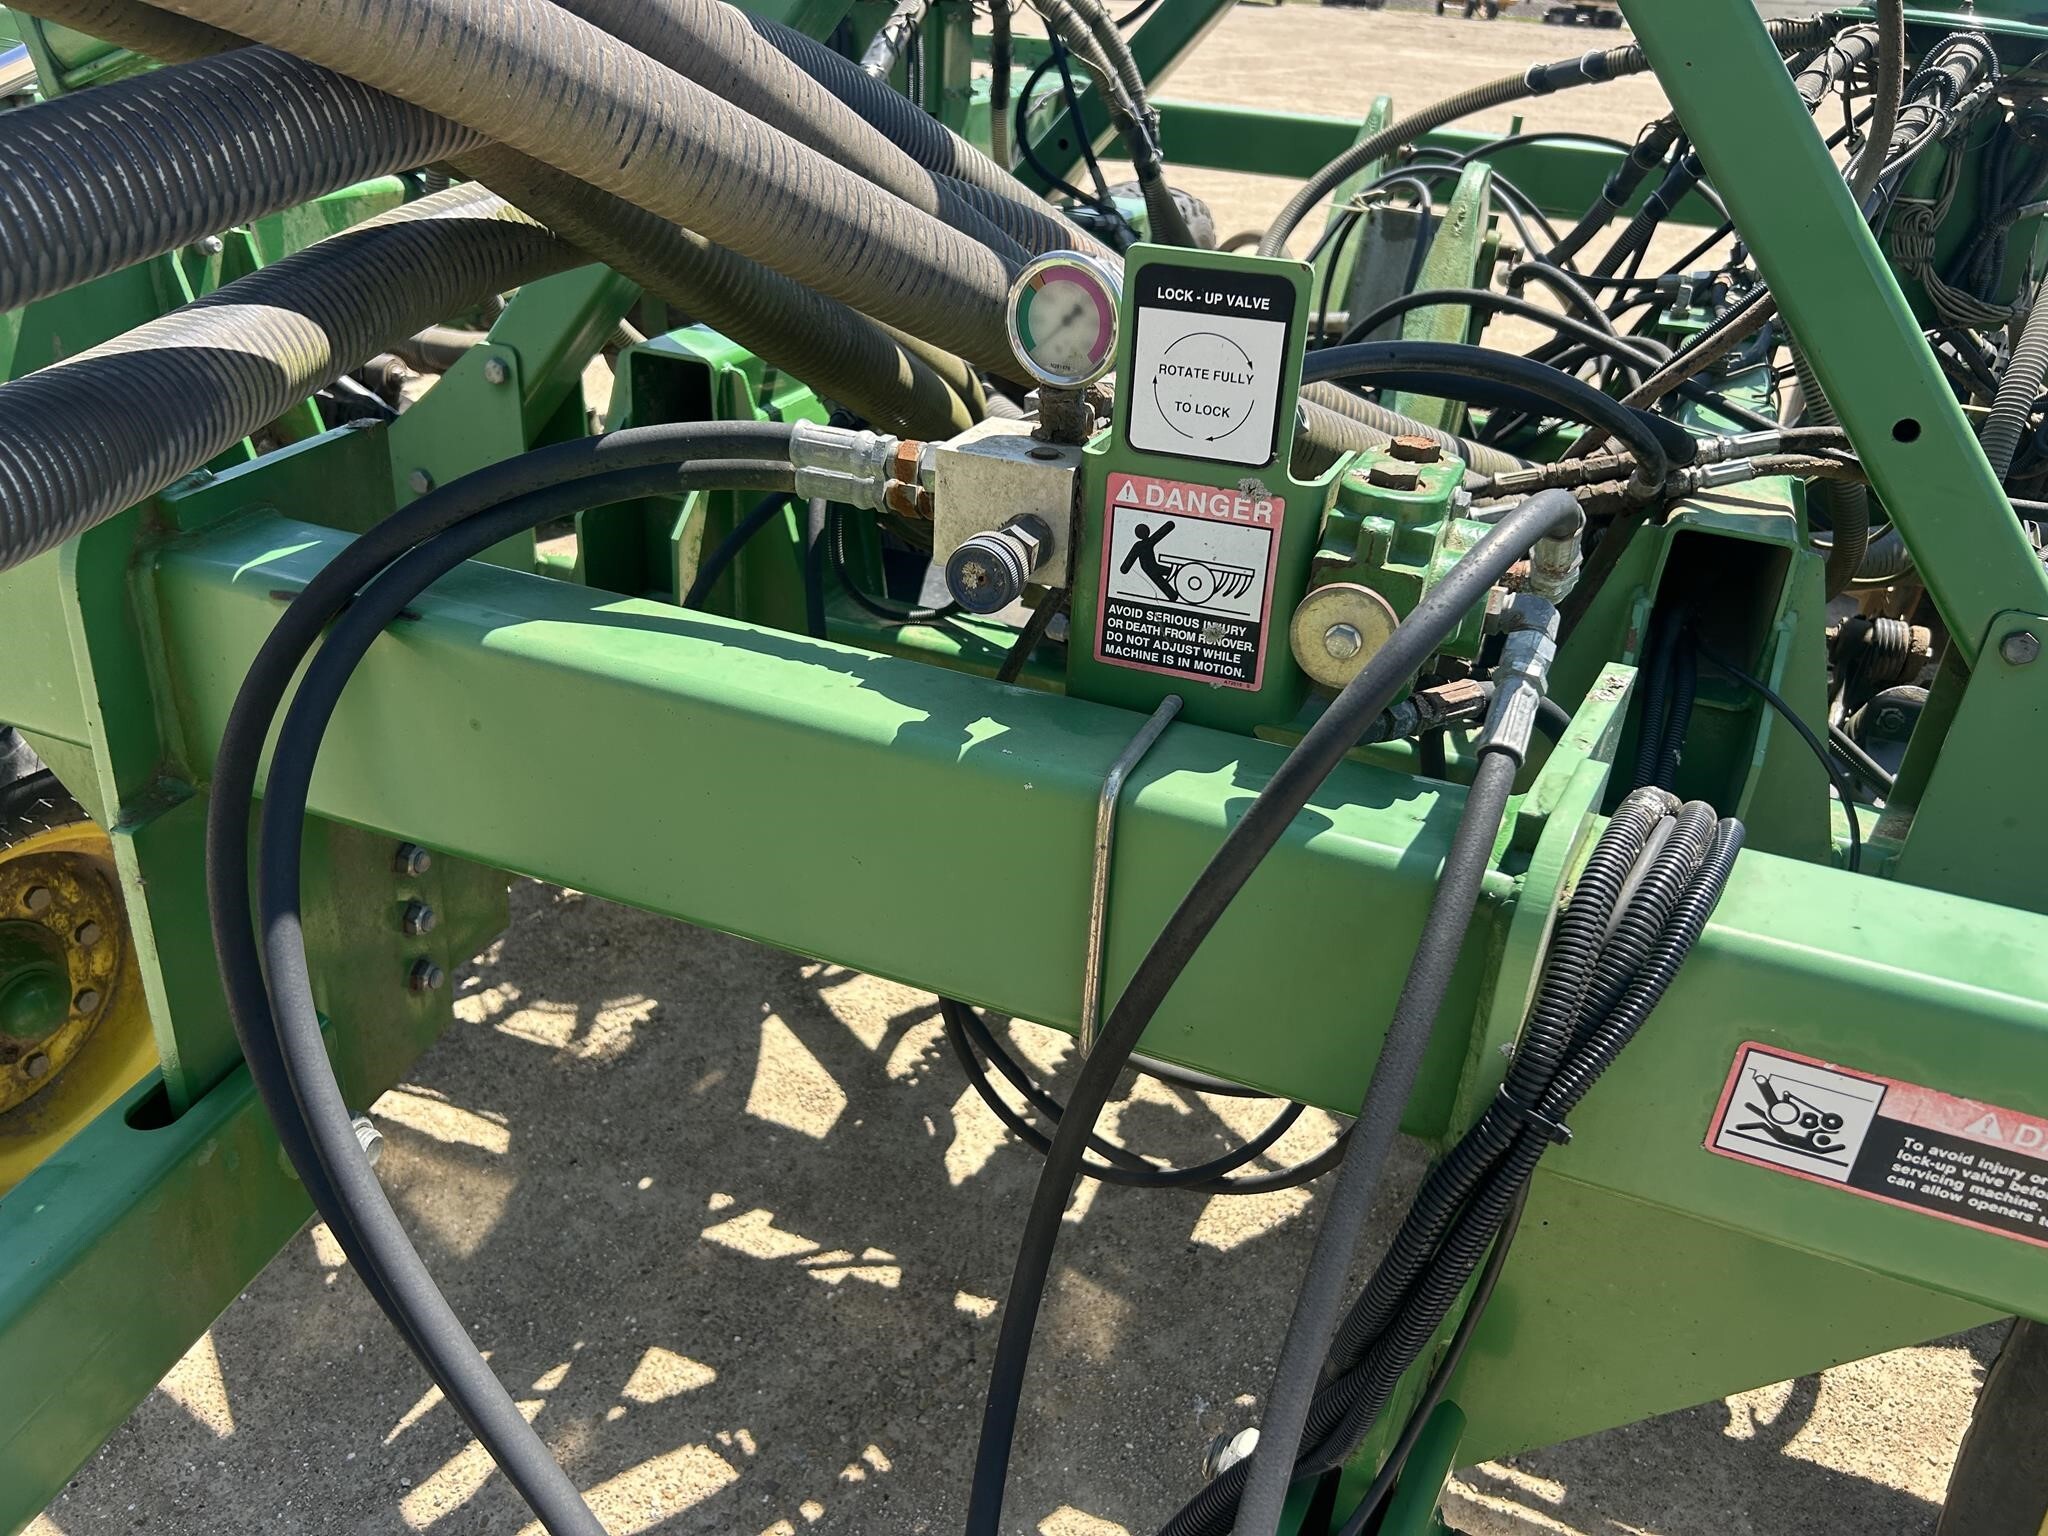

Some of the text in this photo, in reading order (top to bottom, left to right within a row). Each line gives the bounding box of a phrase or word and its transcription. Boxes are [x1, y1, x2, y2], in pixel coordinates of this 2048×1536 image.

[1157, 286, 1193, 302] LOCK
[1204, 291, 1223, 306] UP
[1225, 293, 1270, 311] VALVE
[1159, 363, 1254, 385] ROTATE FULLY
[1174, 400, 1230, 418] TO LOCK
[1145, 484, 1273, 524] DANGER
[1107, 617, 1124, 629] OR
[1125, 621, 1161, 636] DEATH
[1164, 627, 1196, 642] FROM
[1108, 604, 1143, 619] AVOID
[1146, 611, 1200, 629] SERIOUS
[1105, 643, 1246, 678] MACHINE IS IN MOTION.
[1106, 631, 1241, 664] DO NOT ADJUST WHILE
[2013, 1123, 2048, 1152] D
[1896, 1149, 1957, 1175] lock-up
[1962, 1168, 2005, 1187] valve
[1903, 1136, 1924, 1151] To
[1928, 1146, 1975, 1166] avoid
[1977, 1157, 2026, 1181] injury
[1886, 1174, 1916, 1190] can
[1920, 1183, 1964, 1202] allow
[1967, 1197, 2034, 1223] openers
[1891, 1162, 2043, 1212] servicing machine.
